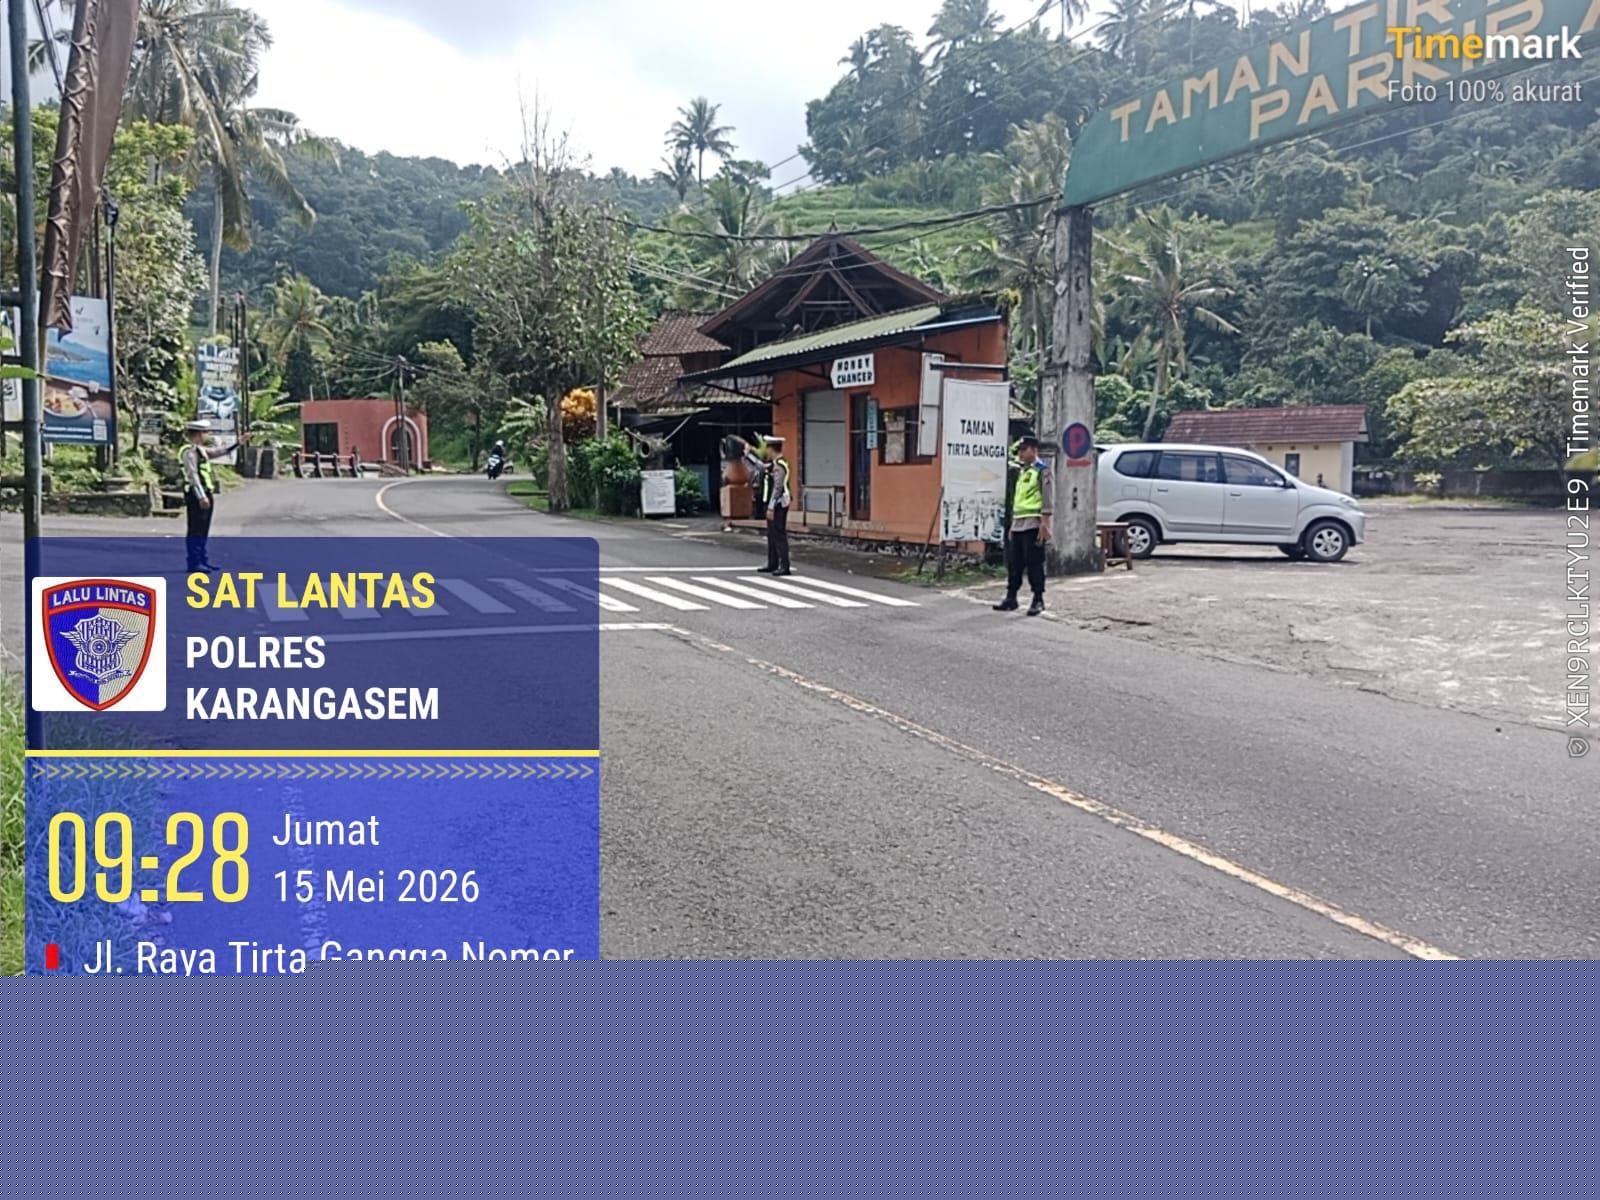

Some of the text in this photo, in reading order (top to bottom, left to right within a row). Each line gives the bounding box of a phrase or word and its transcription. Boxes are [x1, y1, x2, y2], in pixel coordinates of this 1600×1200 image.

[1110, 30, 1311, 142] TAMAN
[837, 357, 870, 371] MONEY
[960, 419, 994, 436] TAMAN
[947, 442, 1005, 458] TIRTA GANGGA
